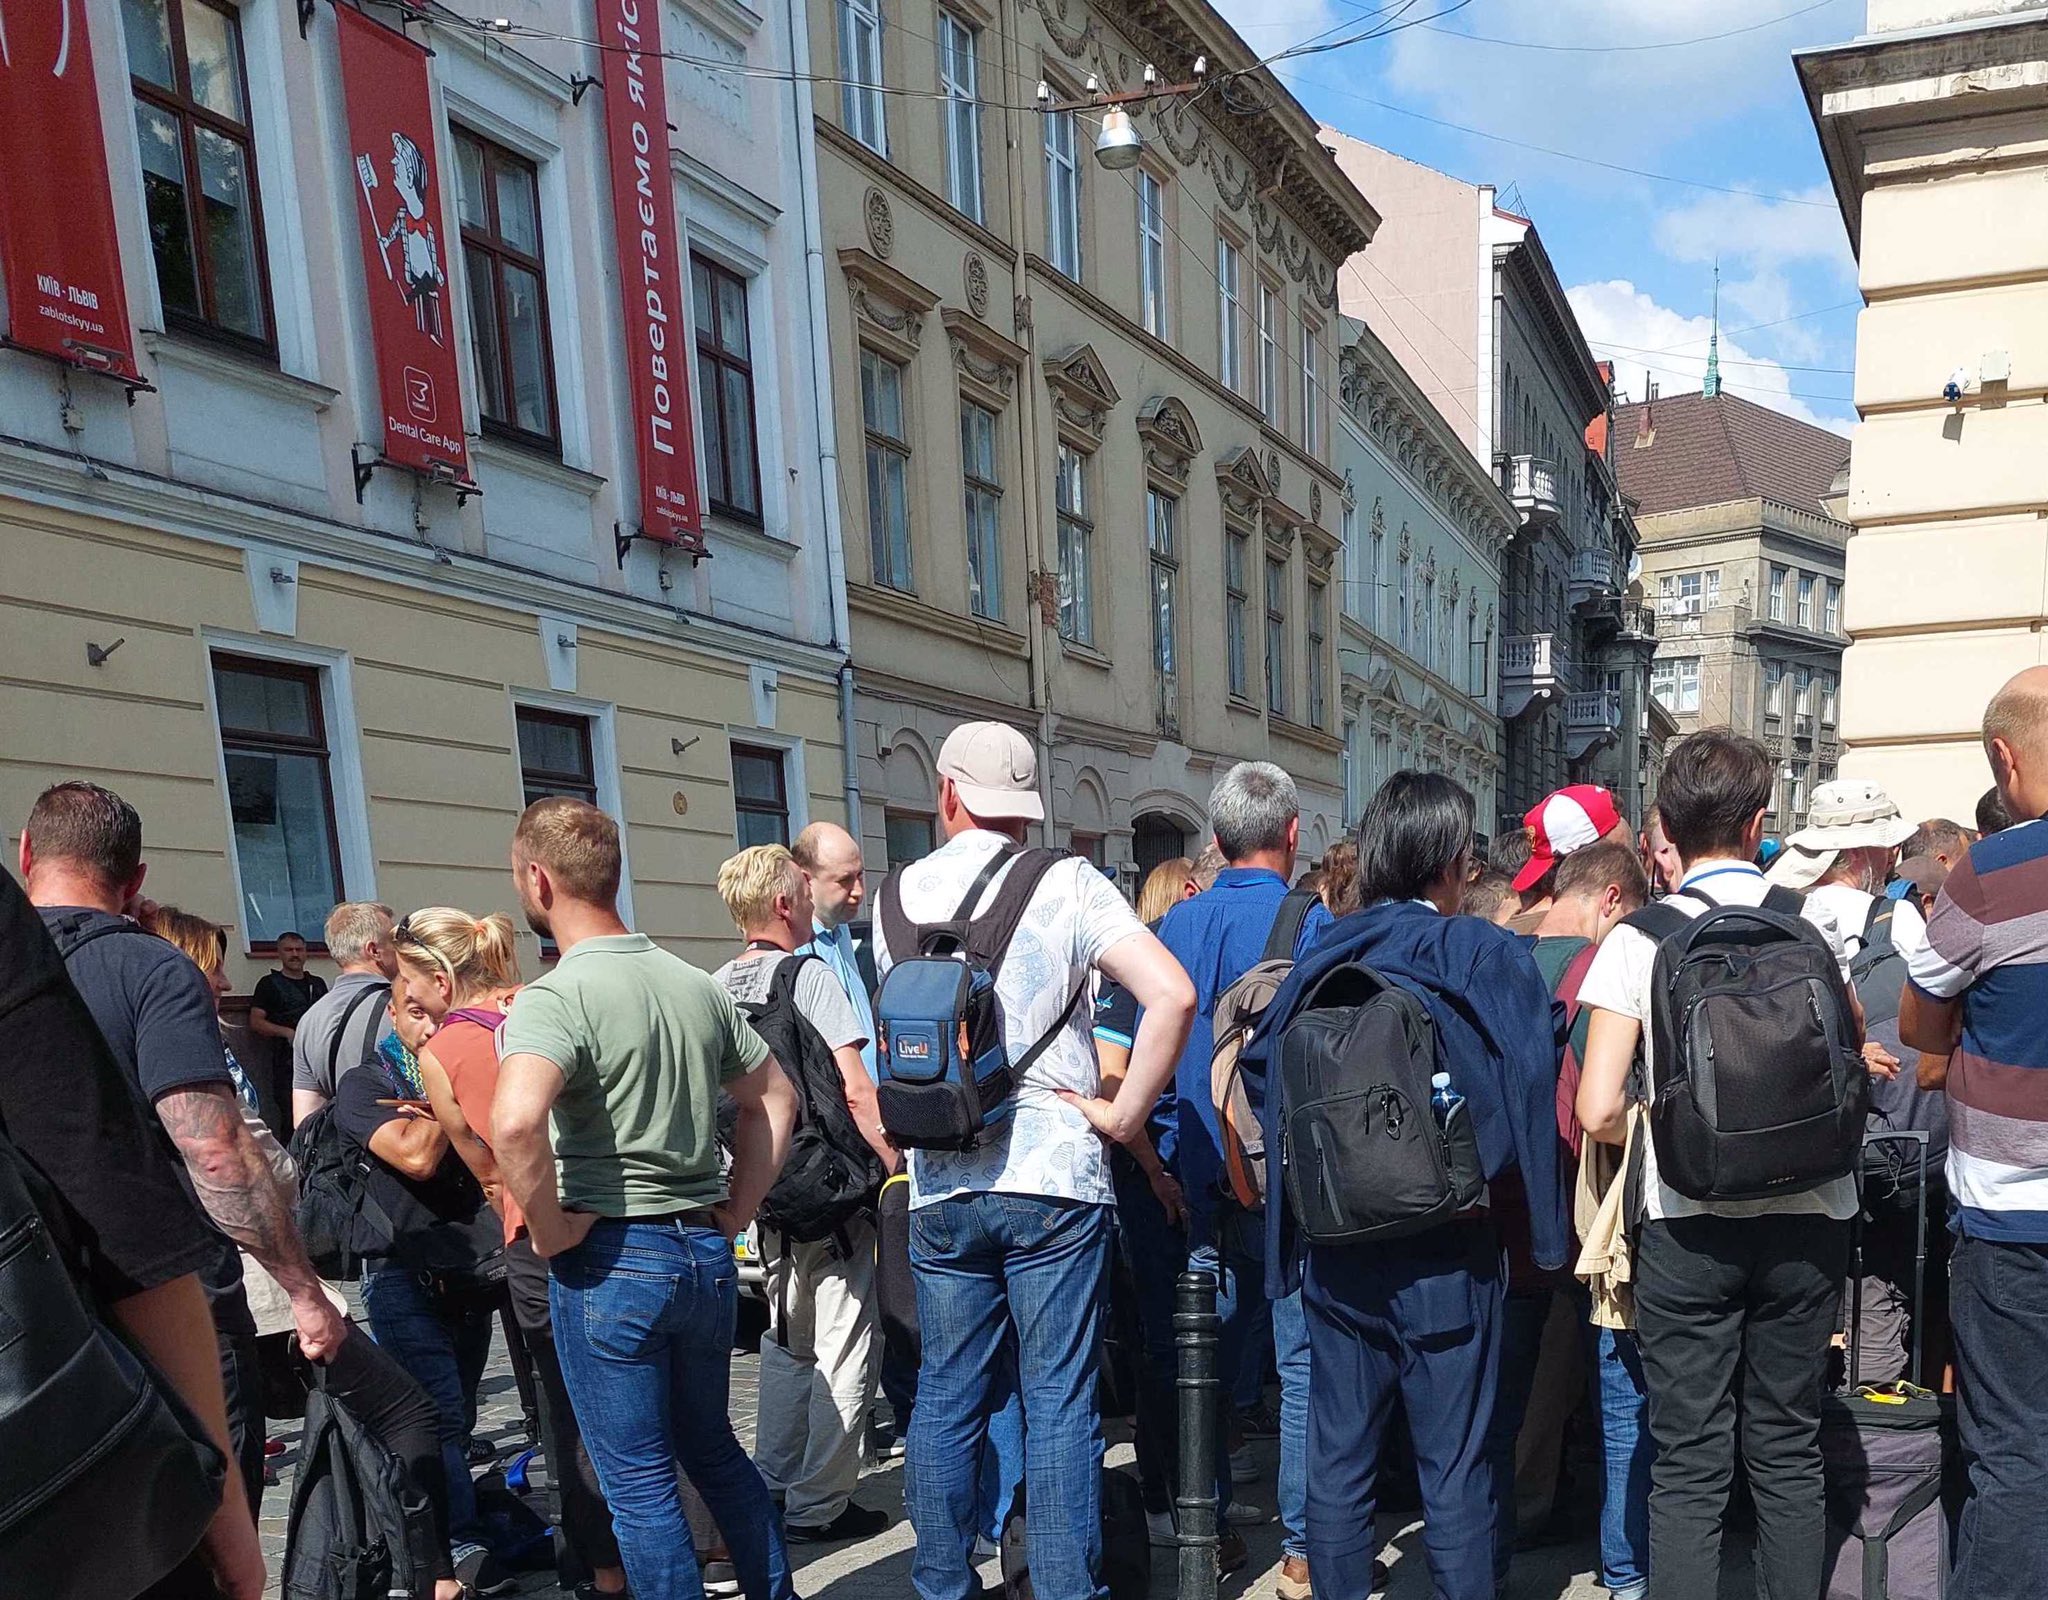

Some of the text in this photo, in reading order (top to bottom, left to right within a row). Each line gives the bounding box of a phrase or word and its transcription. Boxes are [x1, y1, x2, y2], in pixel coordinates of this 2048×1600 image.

[36, 274, 60, 297] КИЇВ
[68, 286, 98, 309] ЛЬВІВ
[631, 121, 674, 455] Повертаємо
[39, 305, 104, 334] zablotskyy.ua
[388, 415, 461, 454] Dental Care App
[899, 1041, 928, 1054] LiveU
